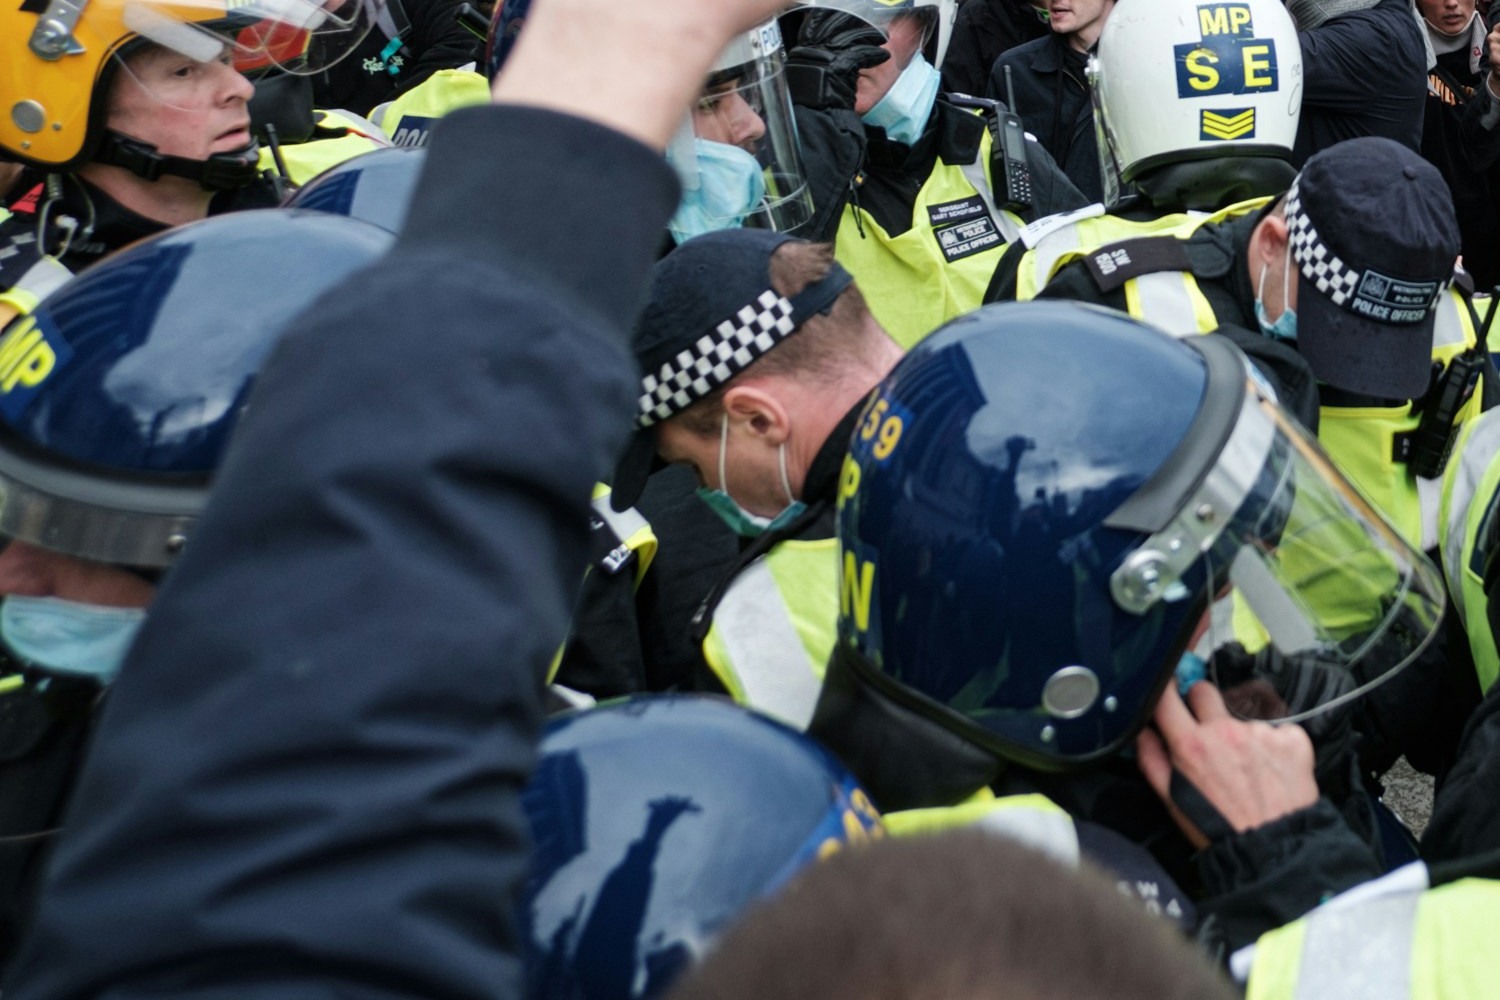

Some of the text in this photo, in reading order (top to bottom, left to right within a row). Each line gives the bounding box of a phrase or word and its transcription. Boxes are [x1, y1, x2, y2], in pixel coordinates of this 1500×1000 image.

[1199, 6, 1252, 37] MP
[946, 233, 1000, 257] POLICE OFFICER
[962, 226, 987, 240] POLICE
[1111, 248, 1132, 267] SW
[1352, 297, 1427, 322] POLICE OFFICER
[1395, 294, 1425, 304] POLICE
[0, 314, 56, 393] MP
[858, 388, 904, 461] 59
[836, 452, 862, 511] P
